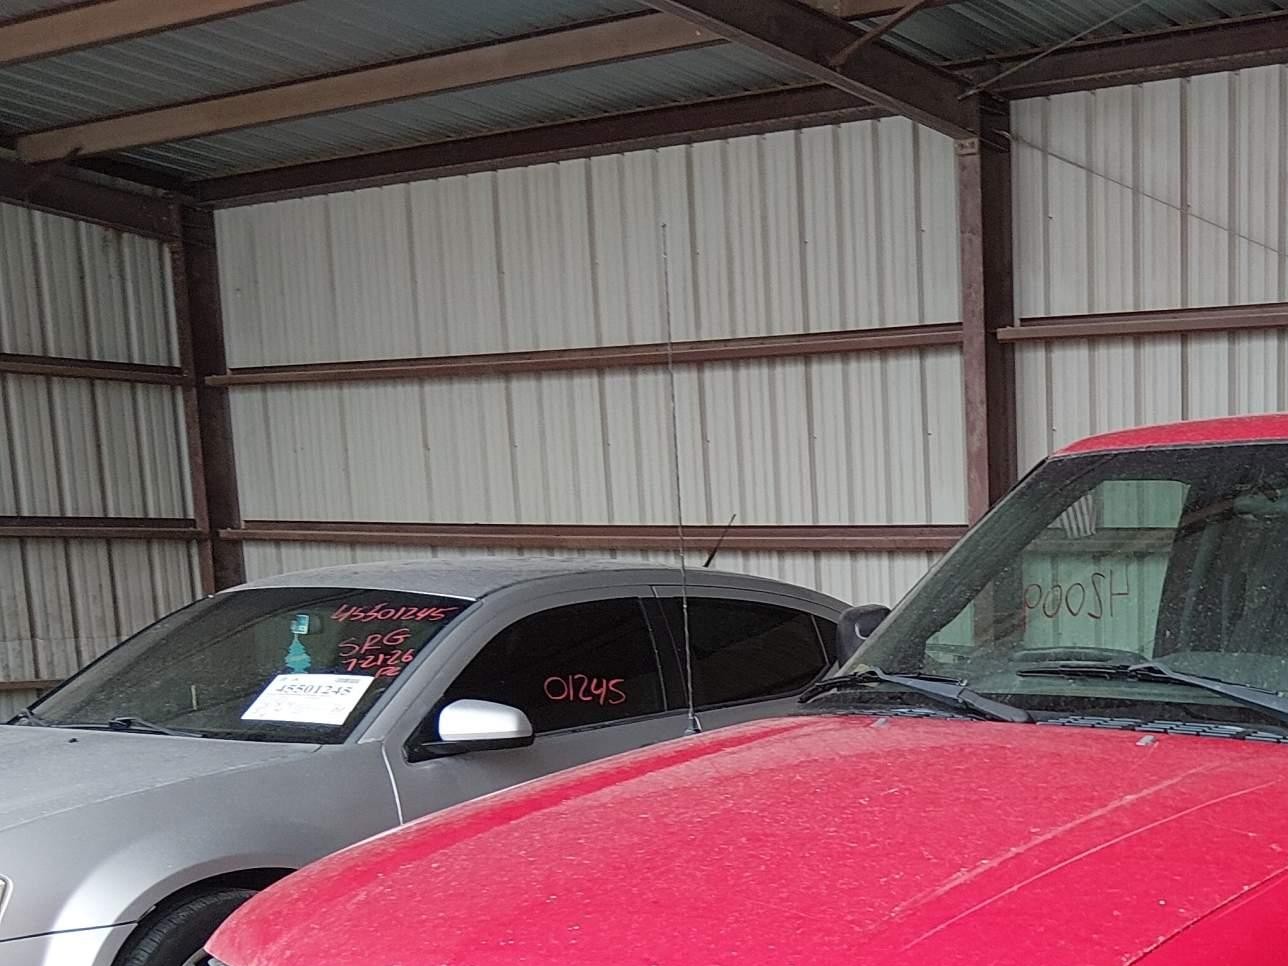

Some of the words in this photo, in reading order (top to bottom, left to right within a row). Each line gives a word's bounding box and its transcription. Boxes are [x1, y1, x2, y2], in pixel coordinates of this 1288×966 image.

[330, 602, 460, 622] 45501245
[338, 628, 411, 656] SRG
[341, 648, 415, 671] 7-21-26
[543, 674, 626, 705] 01245
